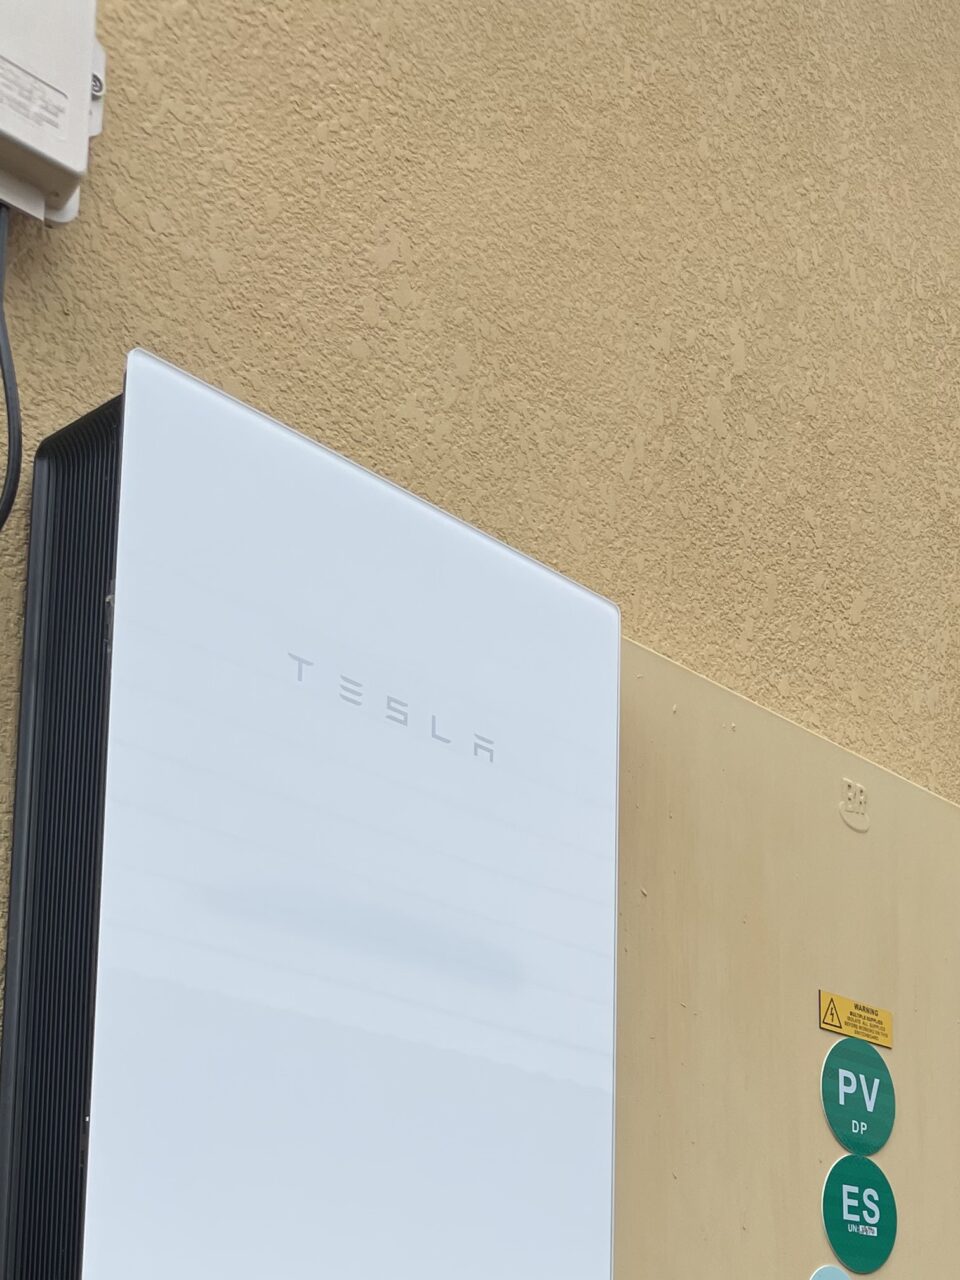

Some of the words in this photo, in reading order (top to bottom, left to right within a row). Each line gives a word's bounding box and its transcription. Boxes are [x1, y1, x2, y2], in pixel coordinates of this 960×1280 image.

[287, 651, 495, 764] TESLA
[854, 1003, 878, 1016] WARNING
[838, 1068, 880, 1113] PV
[851, 1119, 868, 1135] DP
[842, 1184, 880, 1225] ES
